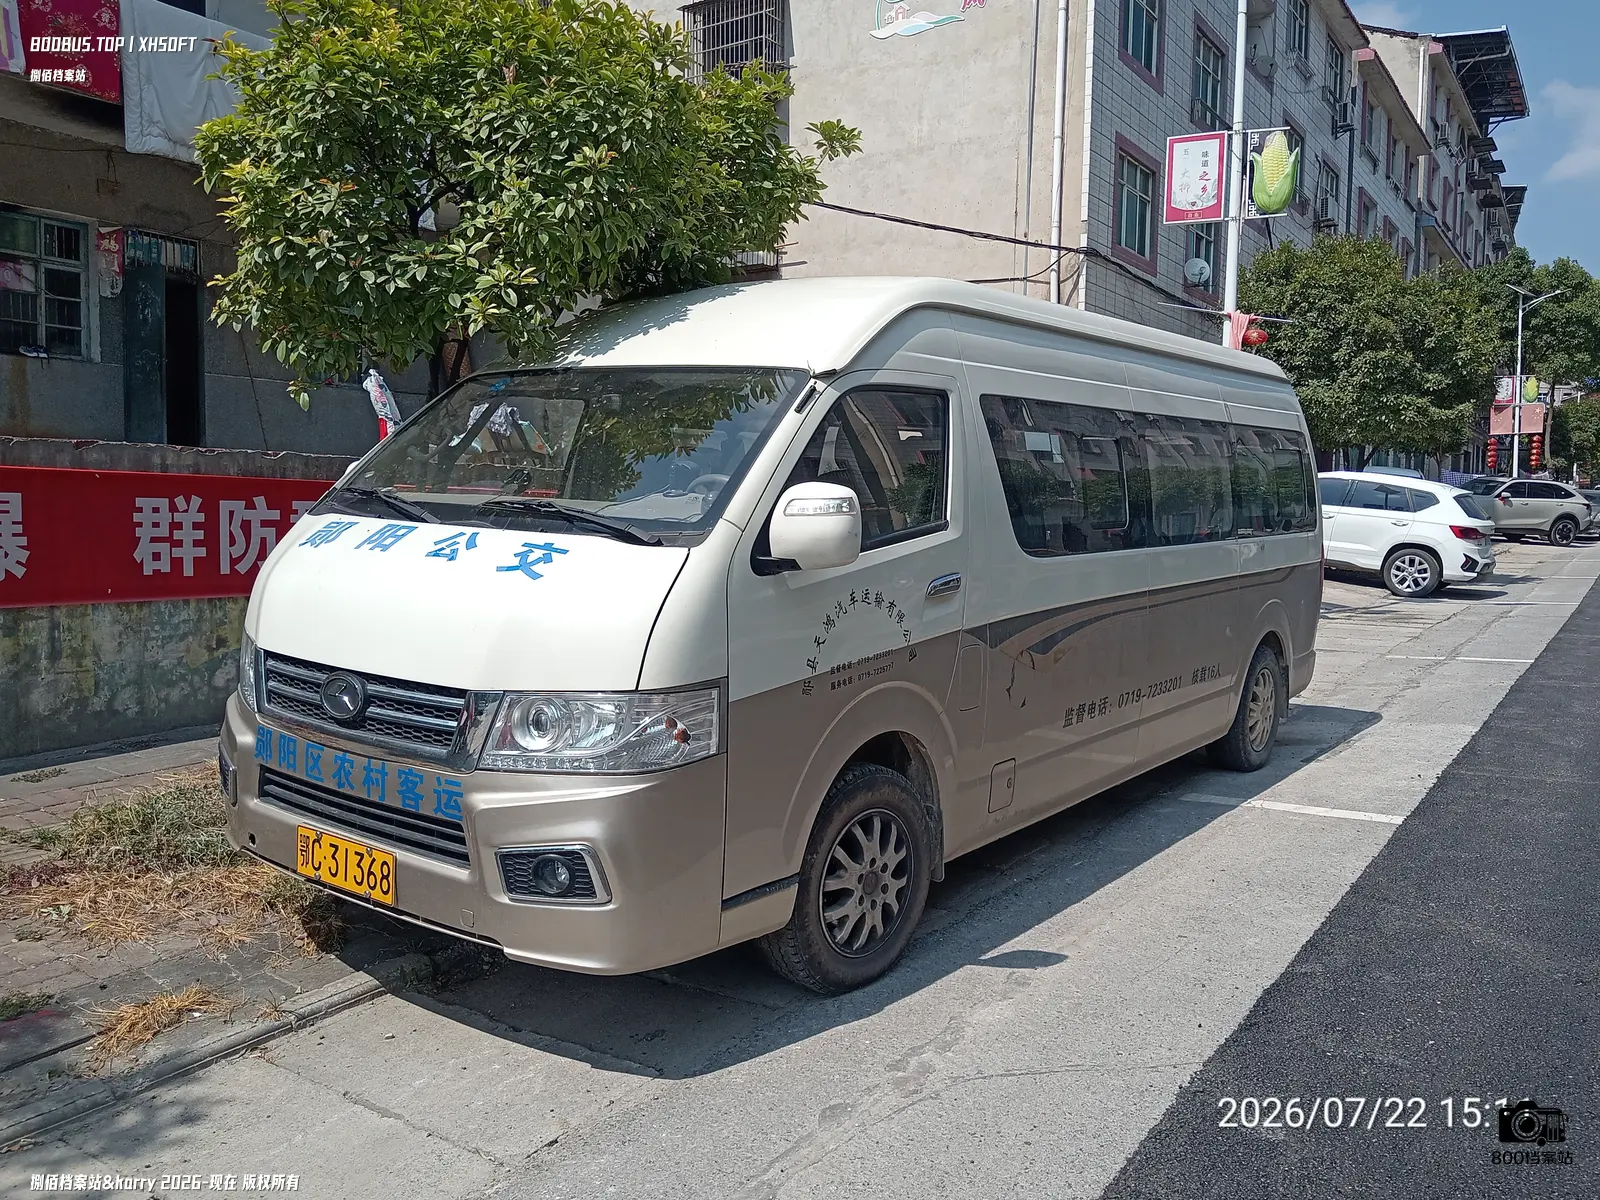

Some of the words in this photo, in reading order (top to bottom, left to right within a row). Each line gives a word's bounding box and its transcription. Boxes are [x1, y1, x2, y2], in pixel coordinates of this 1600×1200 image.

[1198, 150, 1212, 197] 味道之乡
[132, 494, 316, 577] 群防
[298, 521, 570, 581] 郧阳公交
[1191, 662, 1222, 685] 核载16人
[254, 724, 465, 821] 郧阳区农村客运
